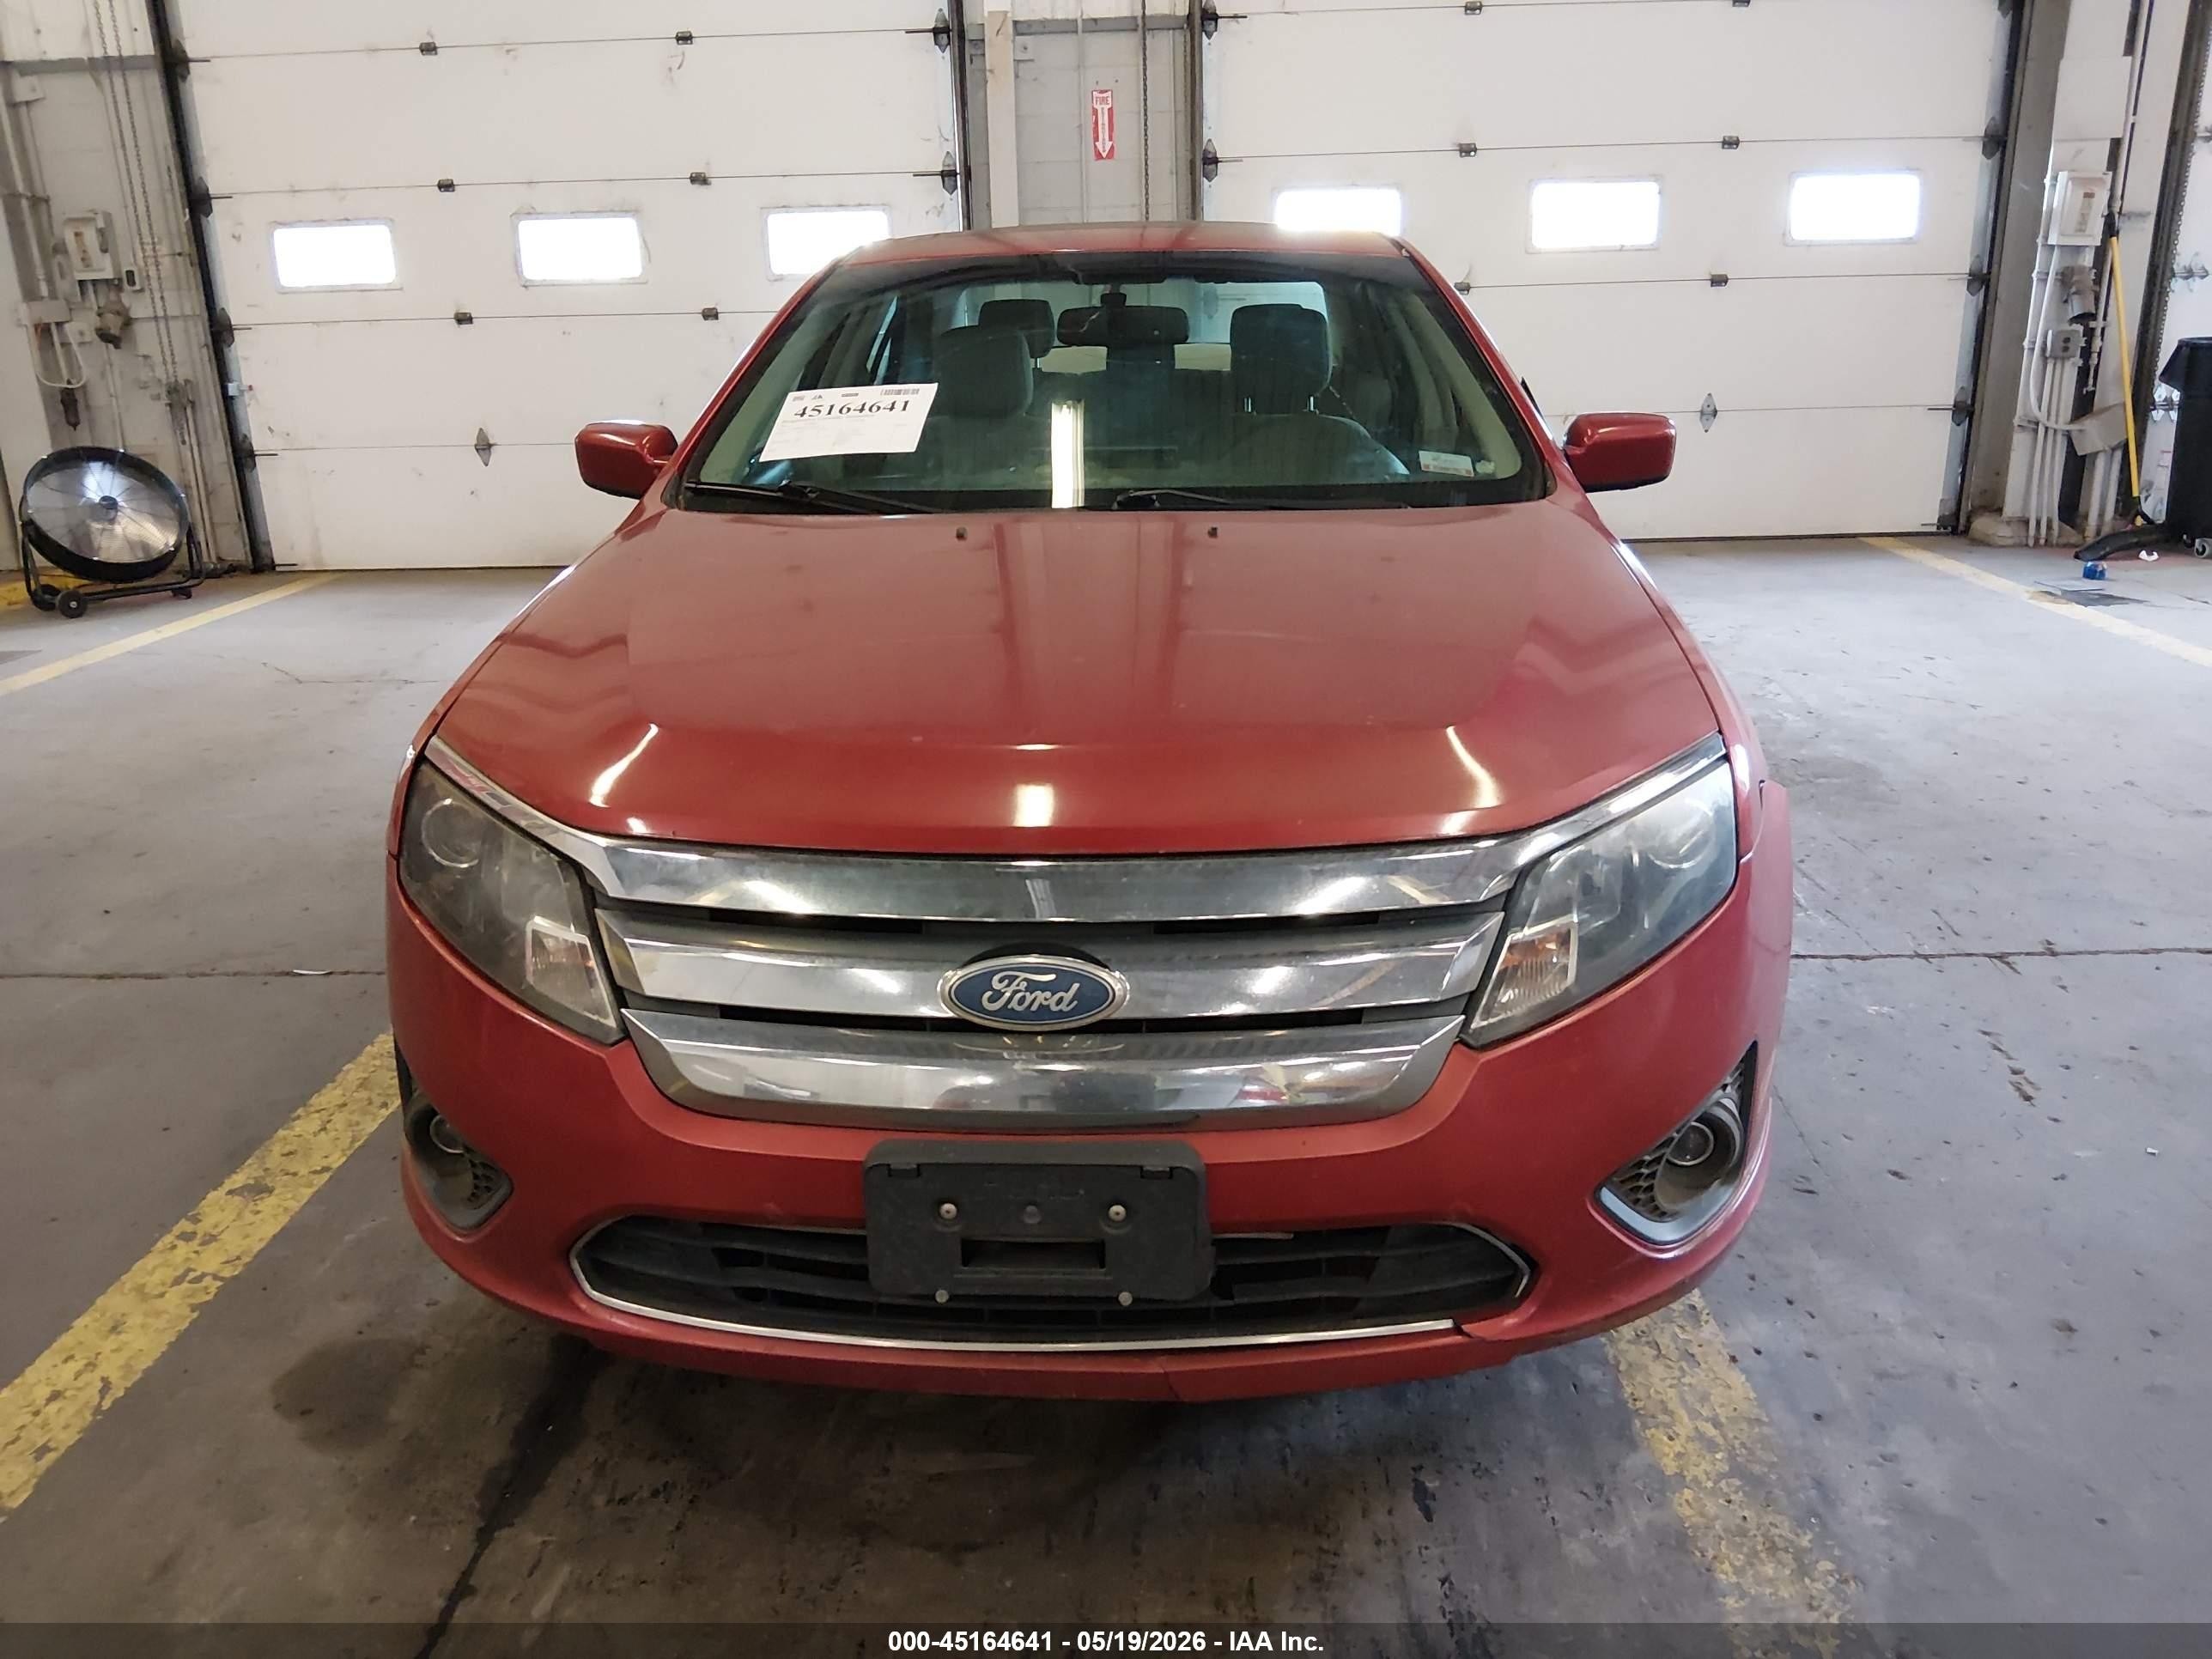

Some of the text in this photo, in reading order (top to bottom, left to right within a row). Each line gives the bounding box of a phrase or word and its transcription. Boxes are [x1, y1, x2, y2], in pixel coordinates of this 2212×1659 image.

[1095, 95, 1110, 105] FIRE
[794, 399, 910, 418] 45164641
[981, 971, 1080, 1012] Ford
